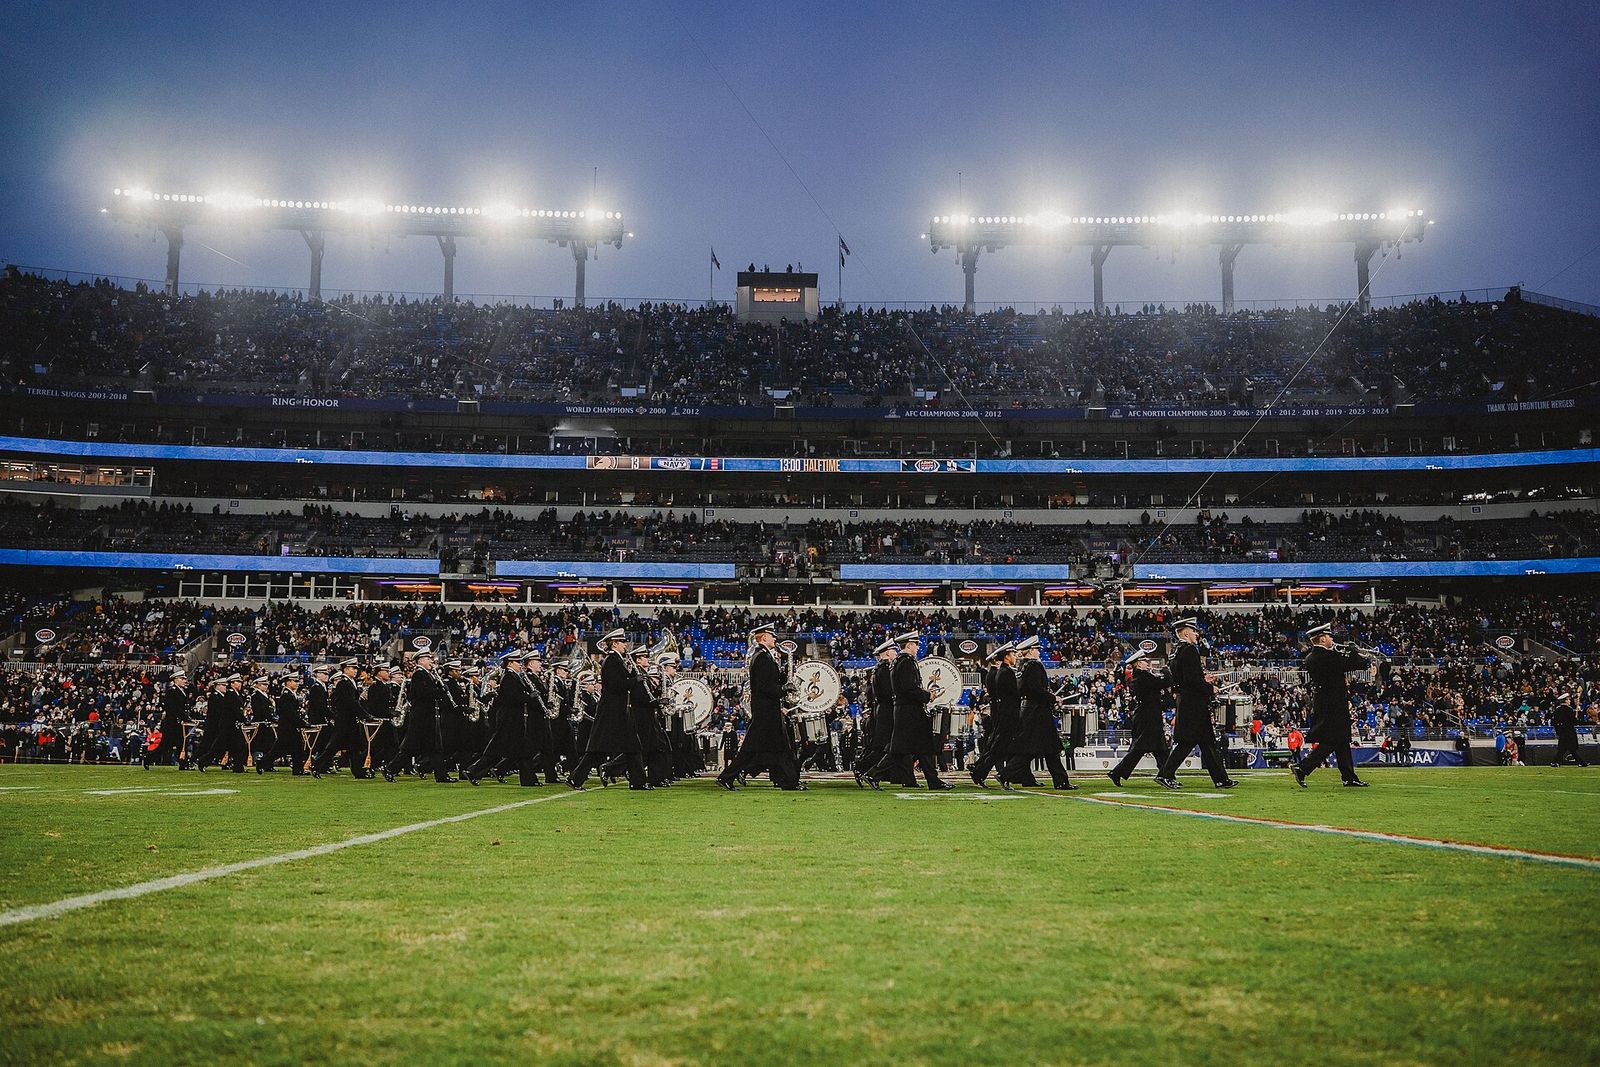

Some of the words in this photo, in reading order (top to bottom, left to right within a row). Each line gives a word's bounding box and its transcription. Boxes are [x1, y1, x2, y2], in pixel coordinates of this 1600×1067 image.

[27, 388, 59, 397] TERRELL
[60, 390, 86, 399] SUGGS
[88, 392, 128, 401] 2003-2018
[272, 398, 296, 406] RING
[302, 399, 339, 407] HONOR
[1487, 403, 1506, 412] THANK
[1506, 403, 1519, 411] YOU
[1520, 401, 1550, 410] FRONTLINE
[565, 406, 591, 414] WORLD
[592, 406, 634, 414] CHAMPIONS
[631, 458, 639, 470] 13
[664, 461, 685, 469] NAVY
[700, 458, 705, 470] 7
[780, 459, 801, 471] 13:00
[803, 459, 840, 471] HALFTIME
[821, 666, 836, 684] ACADEMY
[942, 663, 959, 682] ACADEMY
